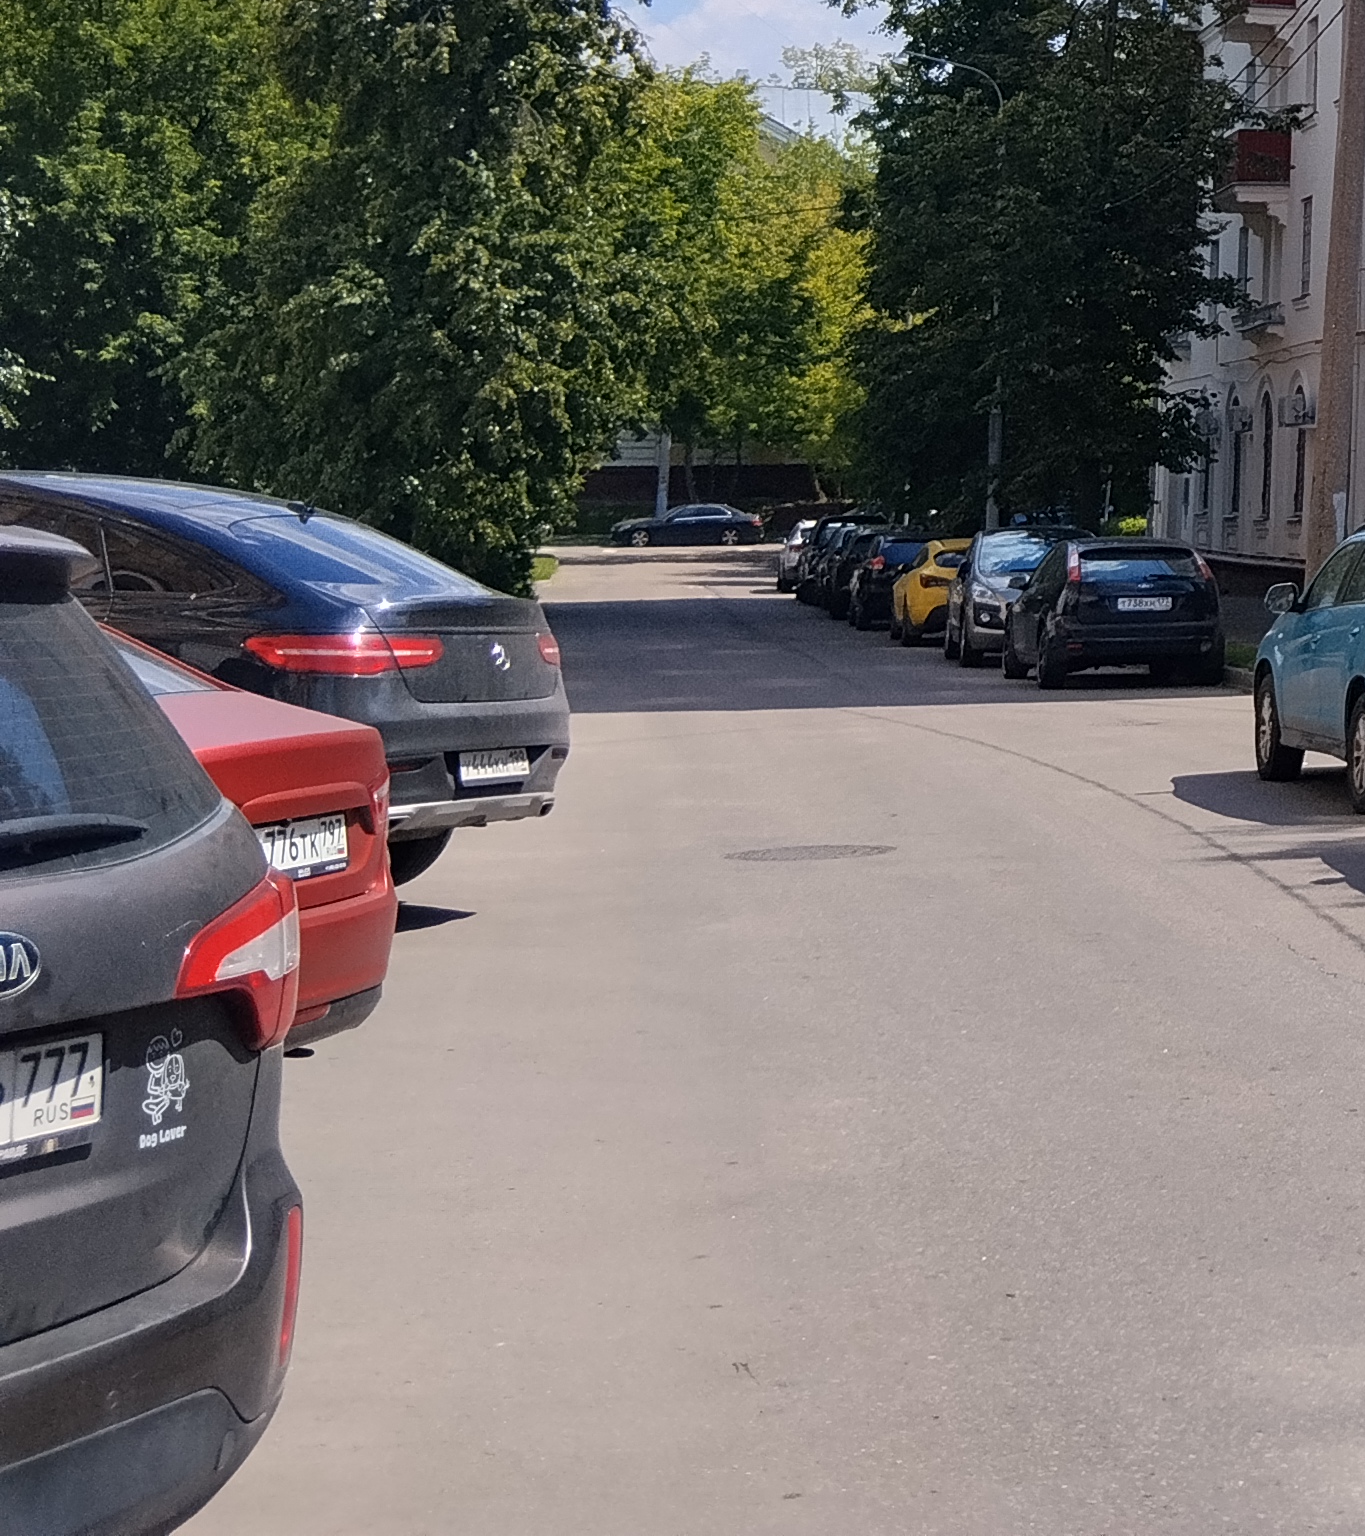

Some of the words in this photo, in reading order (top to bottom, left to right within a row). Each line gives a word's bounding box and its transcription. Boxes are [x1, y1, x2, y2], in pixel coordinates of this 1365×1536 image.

[265, 827, 319, 866] 776ТК
[320, 818, 342, 847] 797
[21, 1041, 89, 1108] 777
[33, 1102, 69, 1127] RUS
[139, 1132, 158, 1149] Dog
[159, 1125, 187, 1143] Lover
